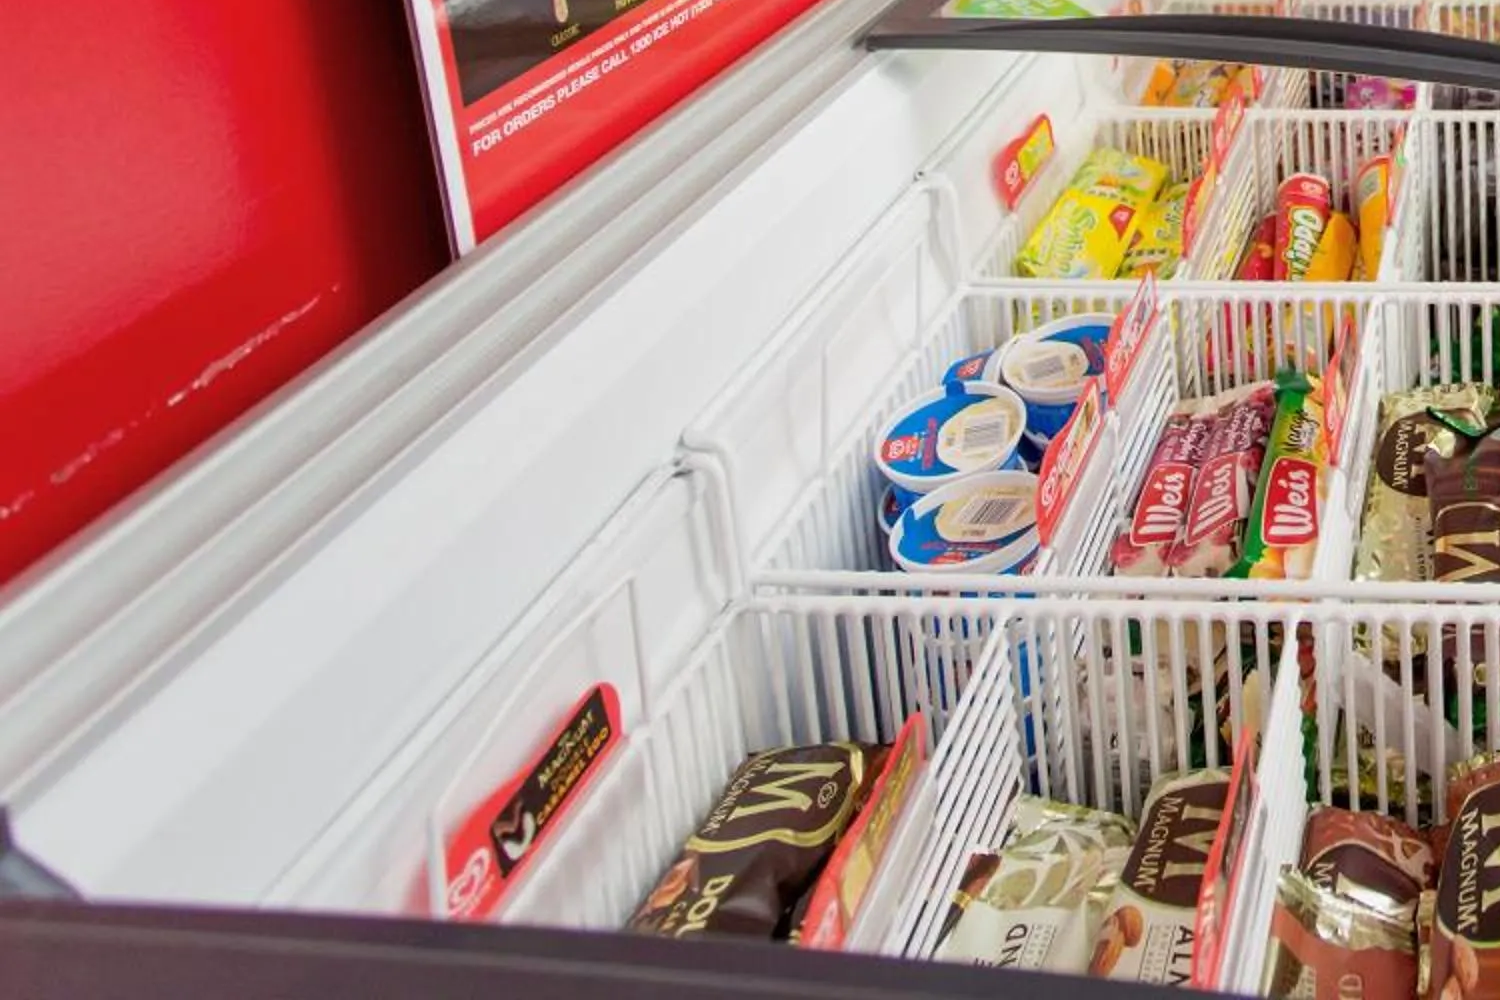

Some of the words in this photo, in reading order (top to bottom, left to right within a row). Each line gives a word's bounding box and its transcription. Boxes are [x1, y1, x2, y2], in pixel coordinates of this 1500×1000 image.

[471, 131, 503, 157] FOR
[502, 95, 557, 136] ORDERS
[556, 65, 602, 104] PLEASE
[601, 50, 630, 75] CALL
[652, 22, 672, 42] ICE
[669, 9, 691, 32] HOT
[1391, 420, 1414, 488] MAGNUM
[1137, 472, 1186, 534] Weis
[1191, 463, 1233, 536] Weis
[1268, 468, 1314, 535] Weis
[702, 756, 770, 835] MAGNUM
[1135, 797, 1185, 892] MAGNUM
[1454, 808, 1480, 930] MAGNUM
